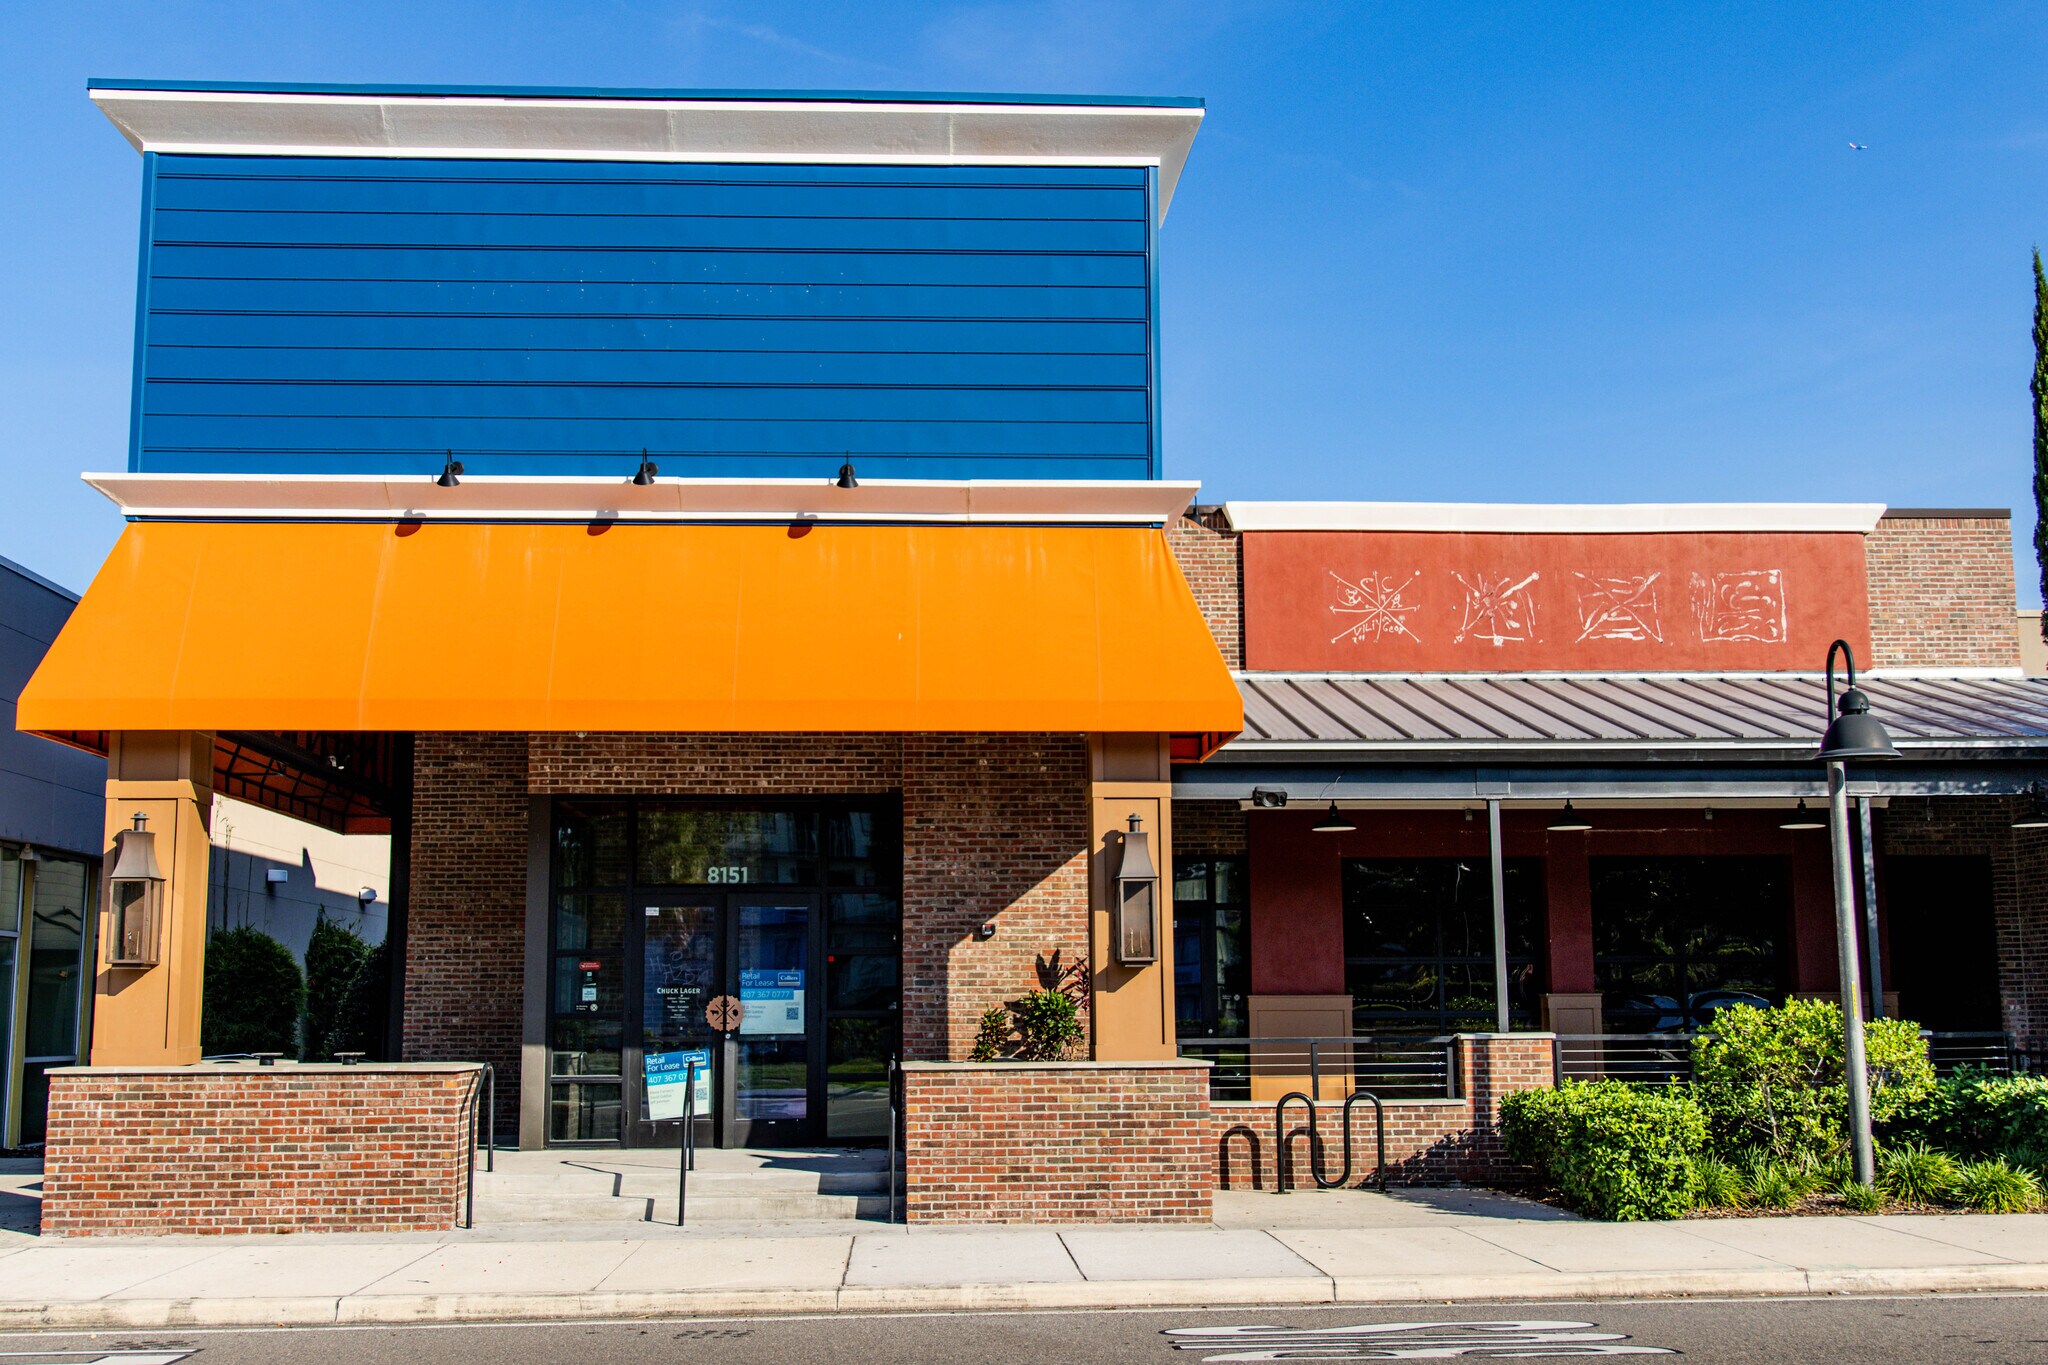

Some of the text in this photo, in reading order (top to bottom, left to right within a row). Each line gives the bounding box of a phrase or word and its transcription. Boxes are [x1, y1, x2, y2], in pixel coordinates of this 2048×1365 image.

[707, 866, 748, 884] 8151
[742, 972, 761, 980] Retail
[646, 1056, 666, 1065] Retail
[647, 1063, 680, 1072] For Lease
[648, 1076, 662, 1084] 407
[663, 1074, 677, 1083] 367
